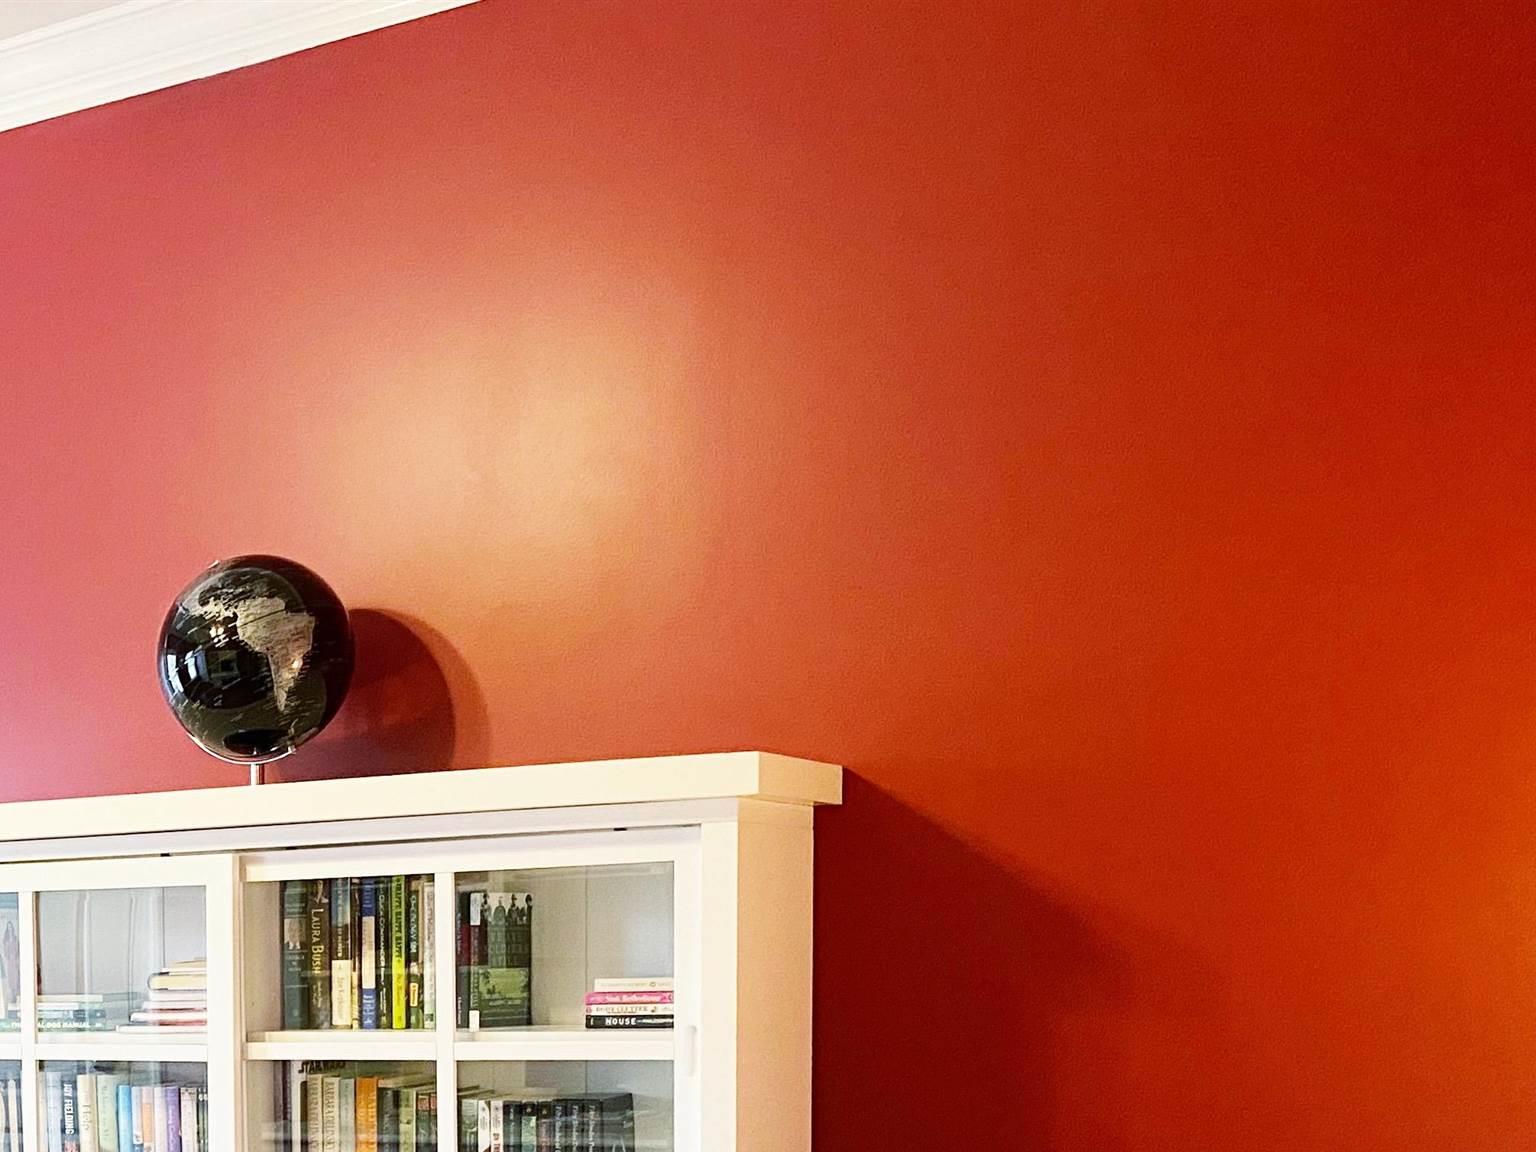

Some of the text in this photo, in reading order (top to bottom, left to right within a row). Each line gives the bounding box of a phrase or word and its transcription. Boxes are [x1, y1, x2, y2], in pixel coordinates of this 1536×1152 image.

[312, 908, 325, 943] LAURA
[312, 945, 325, 974] BUSH
[605, 1017, 637, 1026] HOUSE
[63, 1083, 75, 1135] JOY FIELDING
